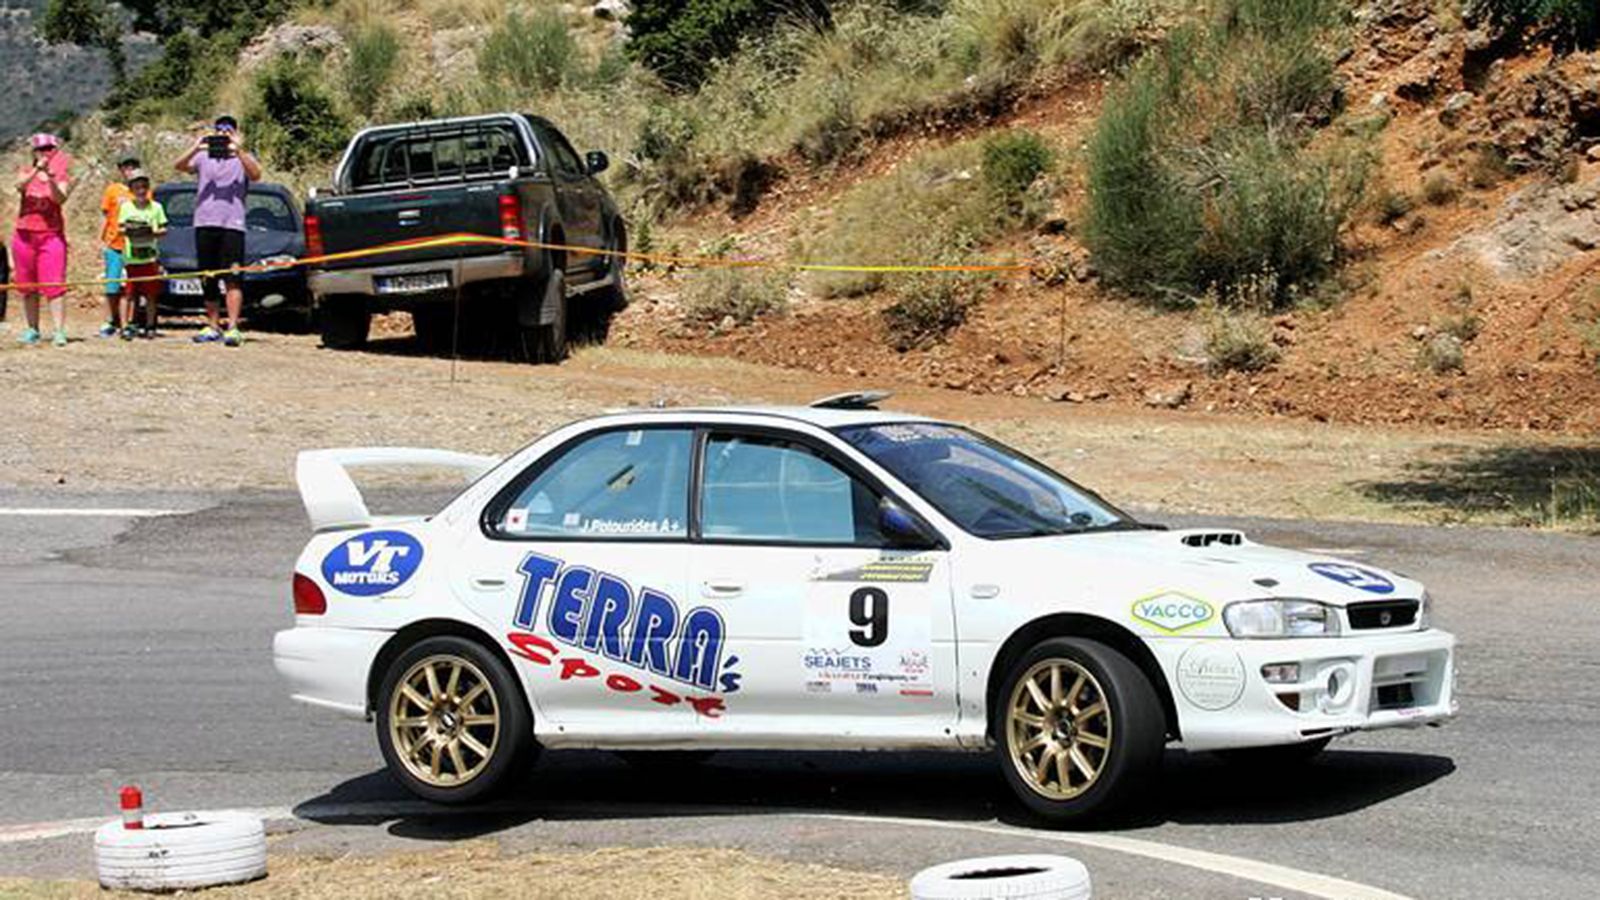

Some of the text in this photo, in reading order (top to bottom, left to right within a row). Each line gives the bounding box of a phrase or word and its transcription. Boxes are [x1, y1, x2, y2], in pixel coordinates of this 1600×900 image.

[346, 540, 410, 572] VT
[333, 570, 400, 585] MOTORS
[848, 586, 888, 647] 9
[1140, 603, 1207, 619] YACCO
[803, 656, 872, 669] SEAJETS
